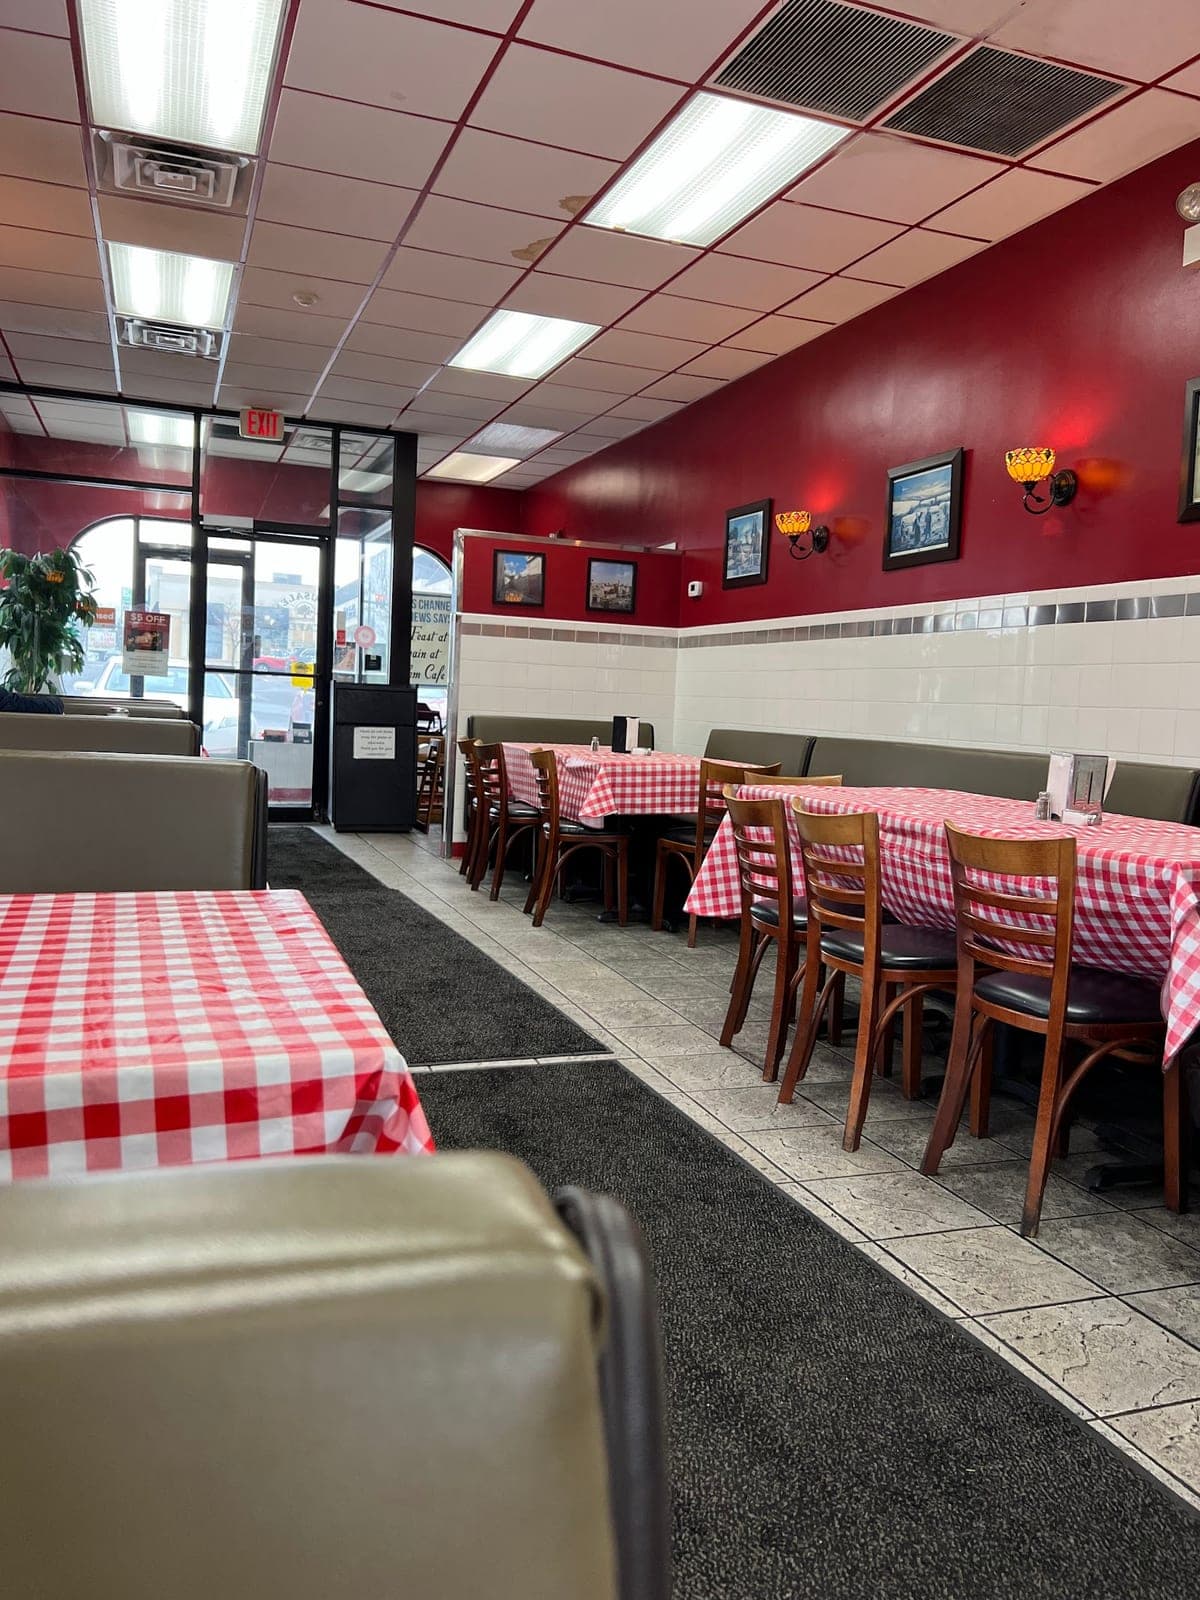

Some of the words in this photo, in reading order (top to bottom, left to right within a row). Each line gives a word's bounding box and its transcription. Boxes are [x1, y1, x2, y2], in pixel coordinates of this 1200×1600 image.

[247, 410, 279, 437] EXIT
[145, 614, 166, 623] OFF
[413, 611, 431, 624] EWS
[410, 625, 437, 641] Feast
[438, 631, 448, 642] at
[410, 648, 427, 659] ain
[429, 648, 442, 659] at
